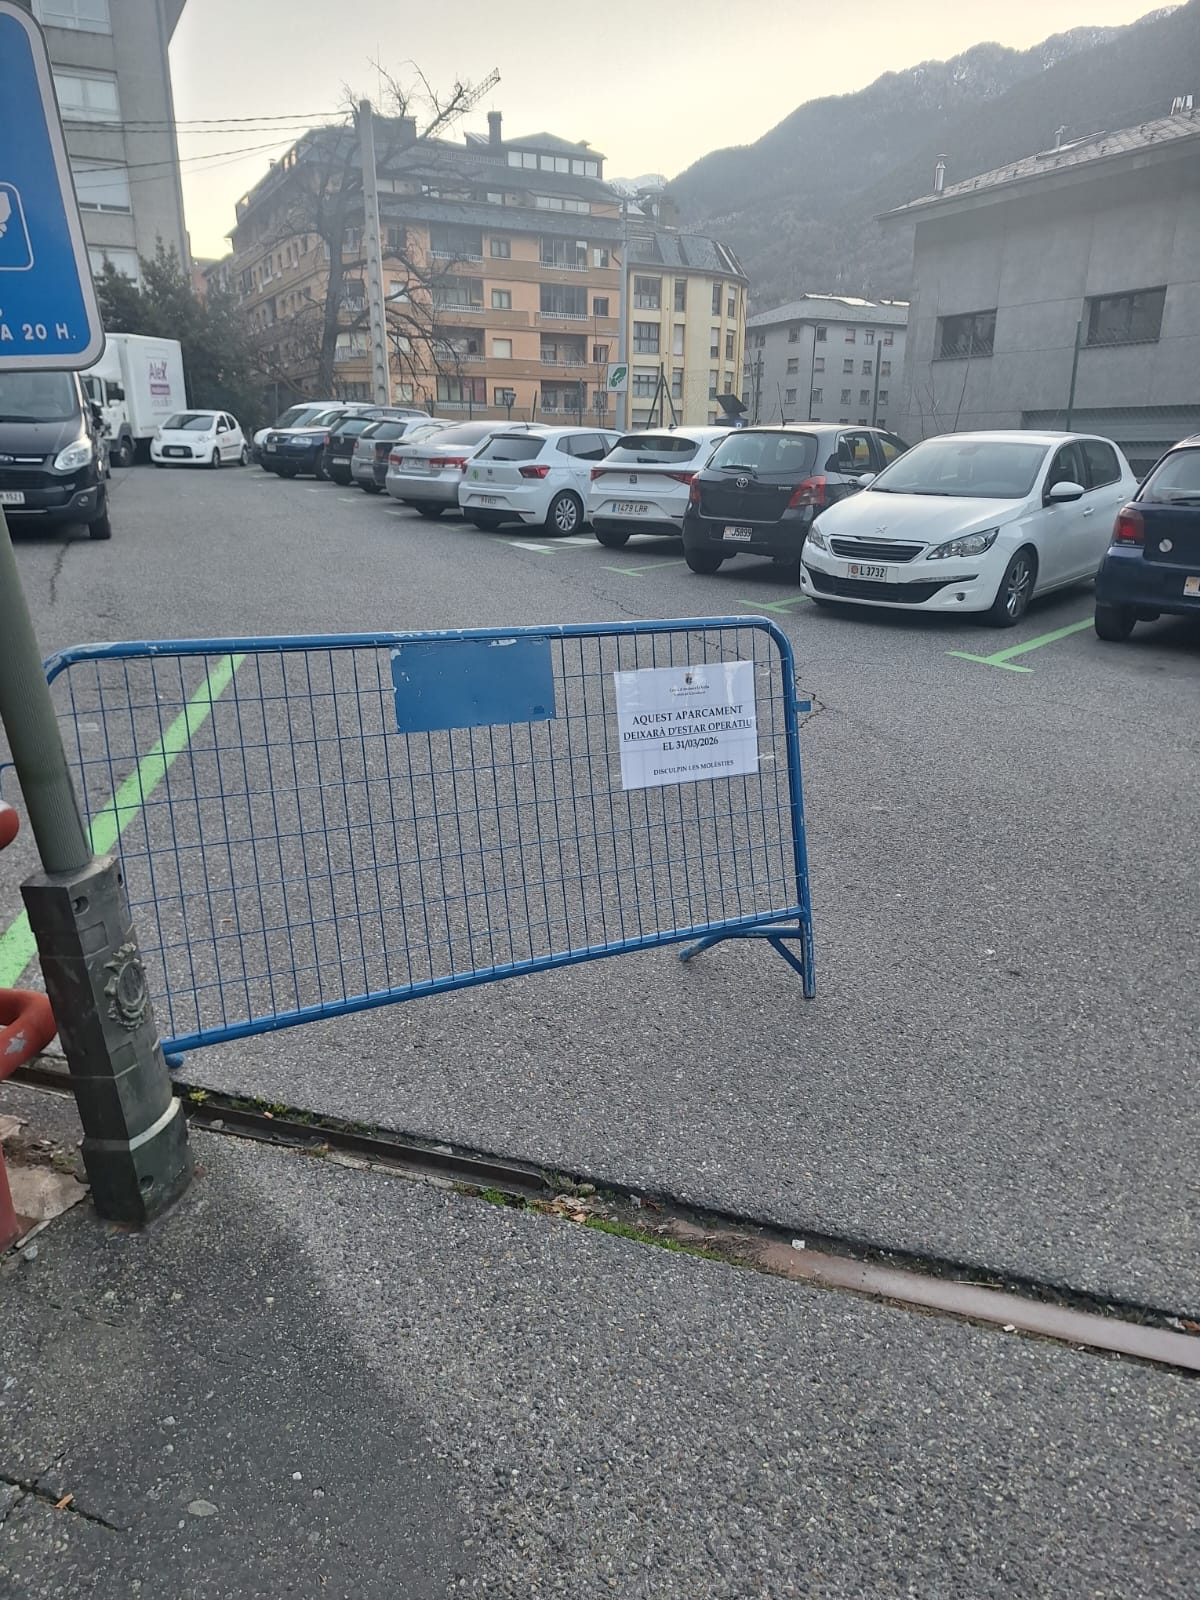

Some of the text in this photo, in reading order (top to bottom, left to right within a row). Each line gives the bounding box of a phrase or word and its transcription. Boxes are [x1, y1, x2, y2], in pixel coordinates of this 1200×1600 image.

[1, 322, 77, 340] A 20 H.
[632, 705, 743, 725] AQUEST APARCAMENT
[623, 718, 752, 741] DEIXARÀ D'ESTAR OPERATIU
[663, 736, 719, 751] EL 31/03/2026
[653, 759, 734, 776] DISCULPIN LES MOLESTIES
